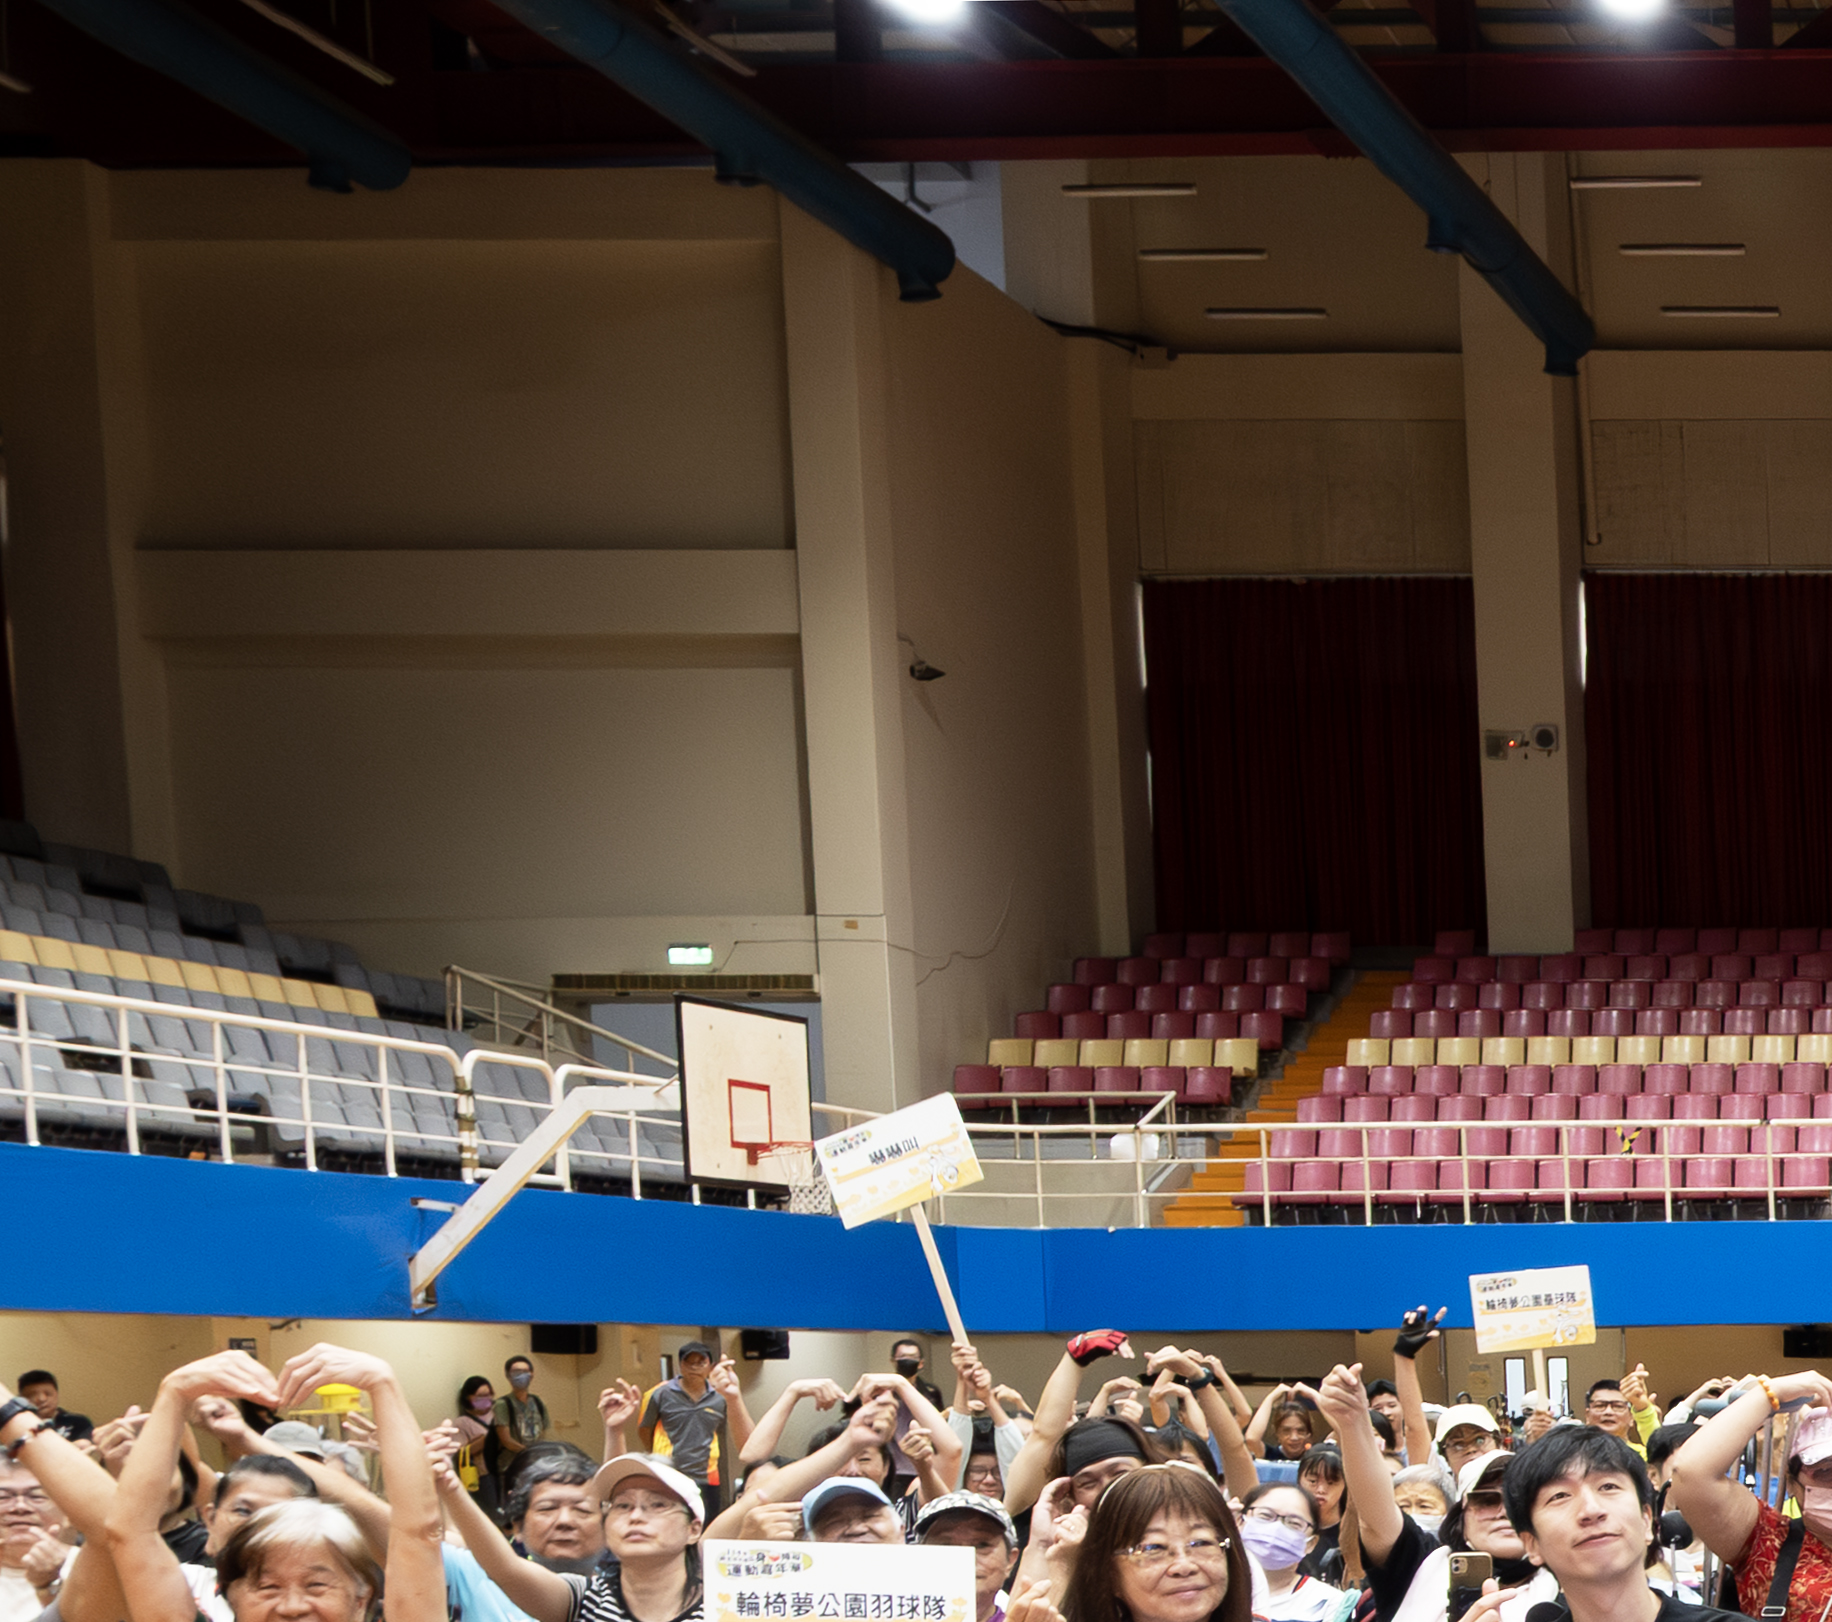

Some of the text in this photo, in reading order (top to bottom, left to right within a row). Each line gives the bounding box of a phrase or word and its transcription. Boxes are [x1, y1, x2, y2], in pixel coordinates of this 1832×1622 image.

[736, 1591, 947, 1620] 輪椅夢公園羽球隊
